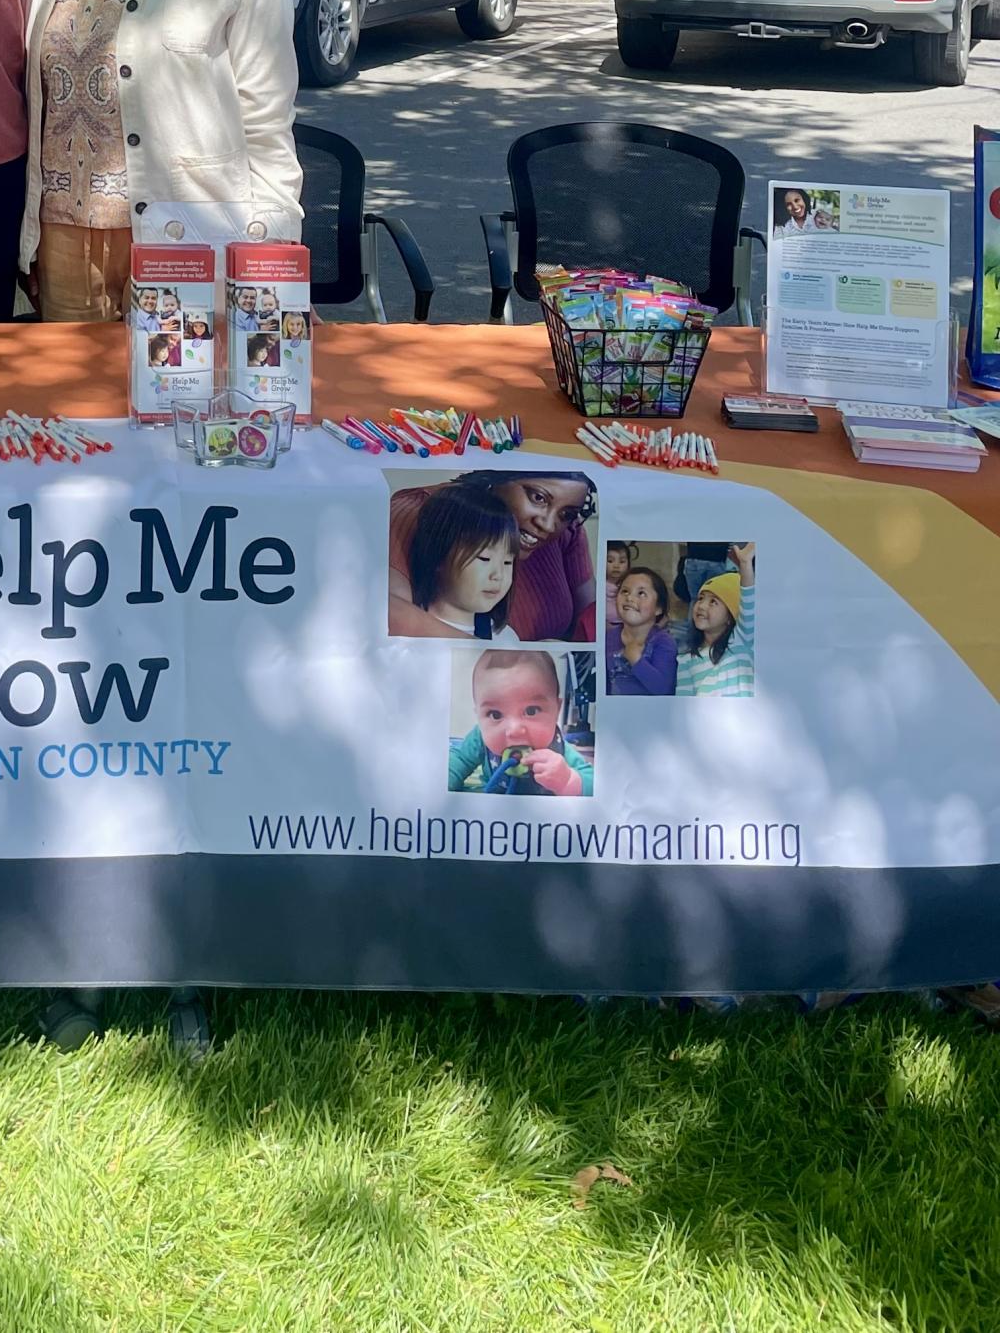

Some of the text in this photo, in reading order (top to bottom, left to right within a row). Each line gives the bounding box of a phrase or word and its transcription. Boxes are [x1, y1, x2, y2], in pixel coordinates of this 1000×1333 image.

[171, 377, 200, 386] Help Me
[271, 377, 299, 386] Help Me
[271, 385, 291, 393] Grow
[126, 505, 297, 606] Me
[37, 739, 232, 780] COUNTY
[247, 808, 803, 867] www.helpmegrowmarin.org
